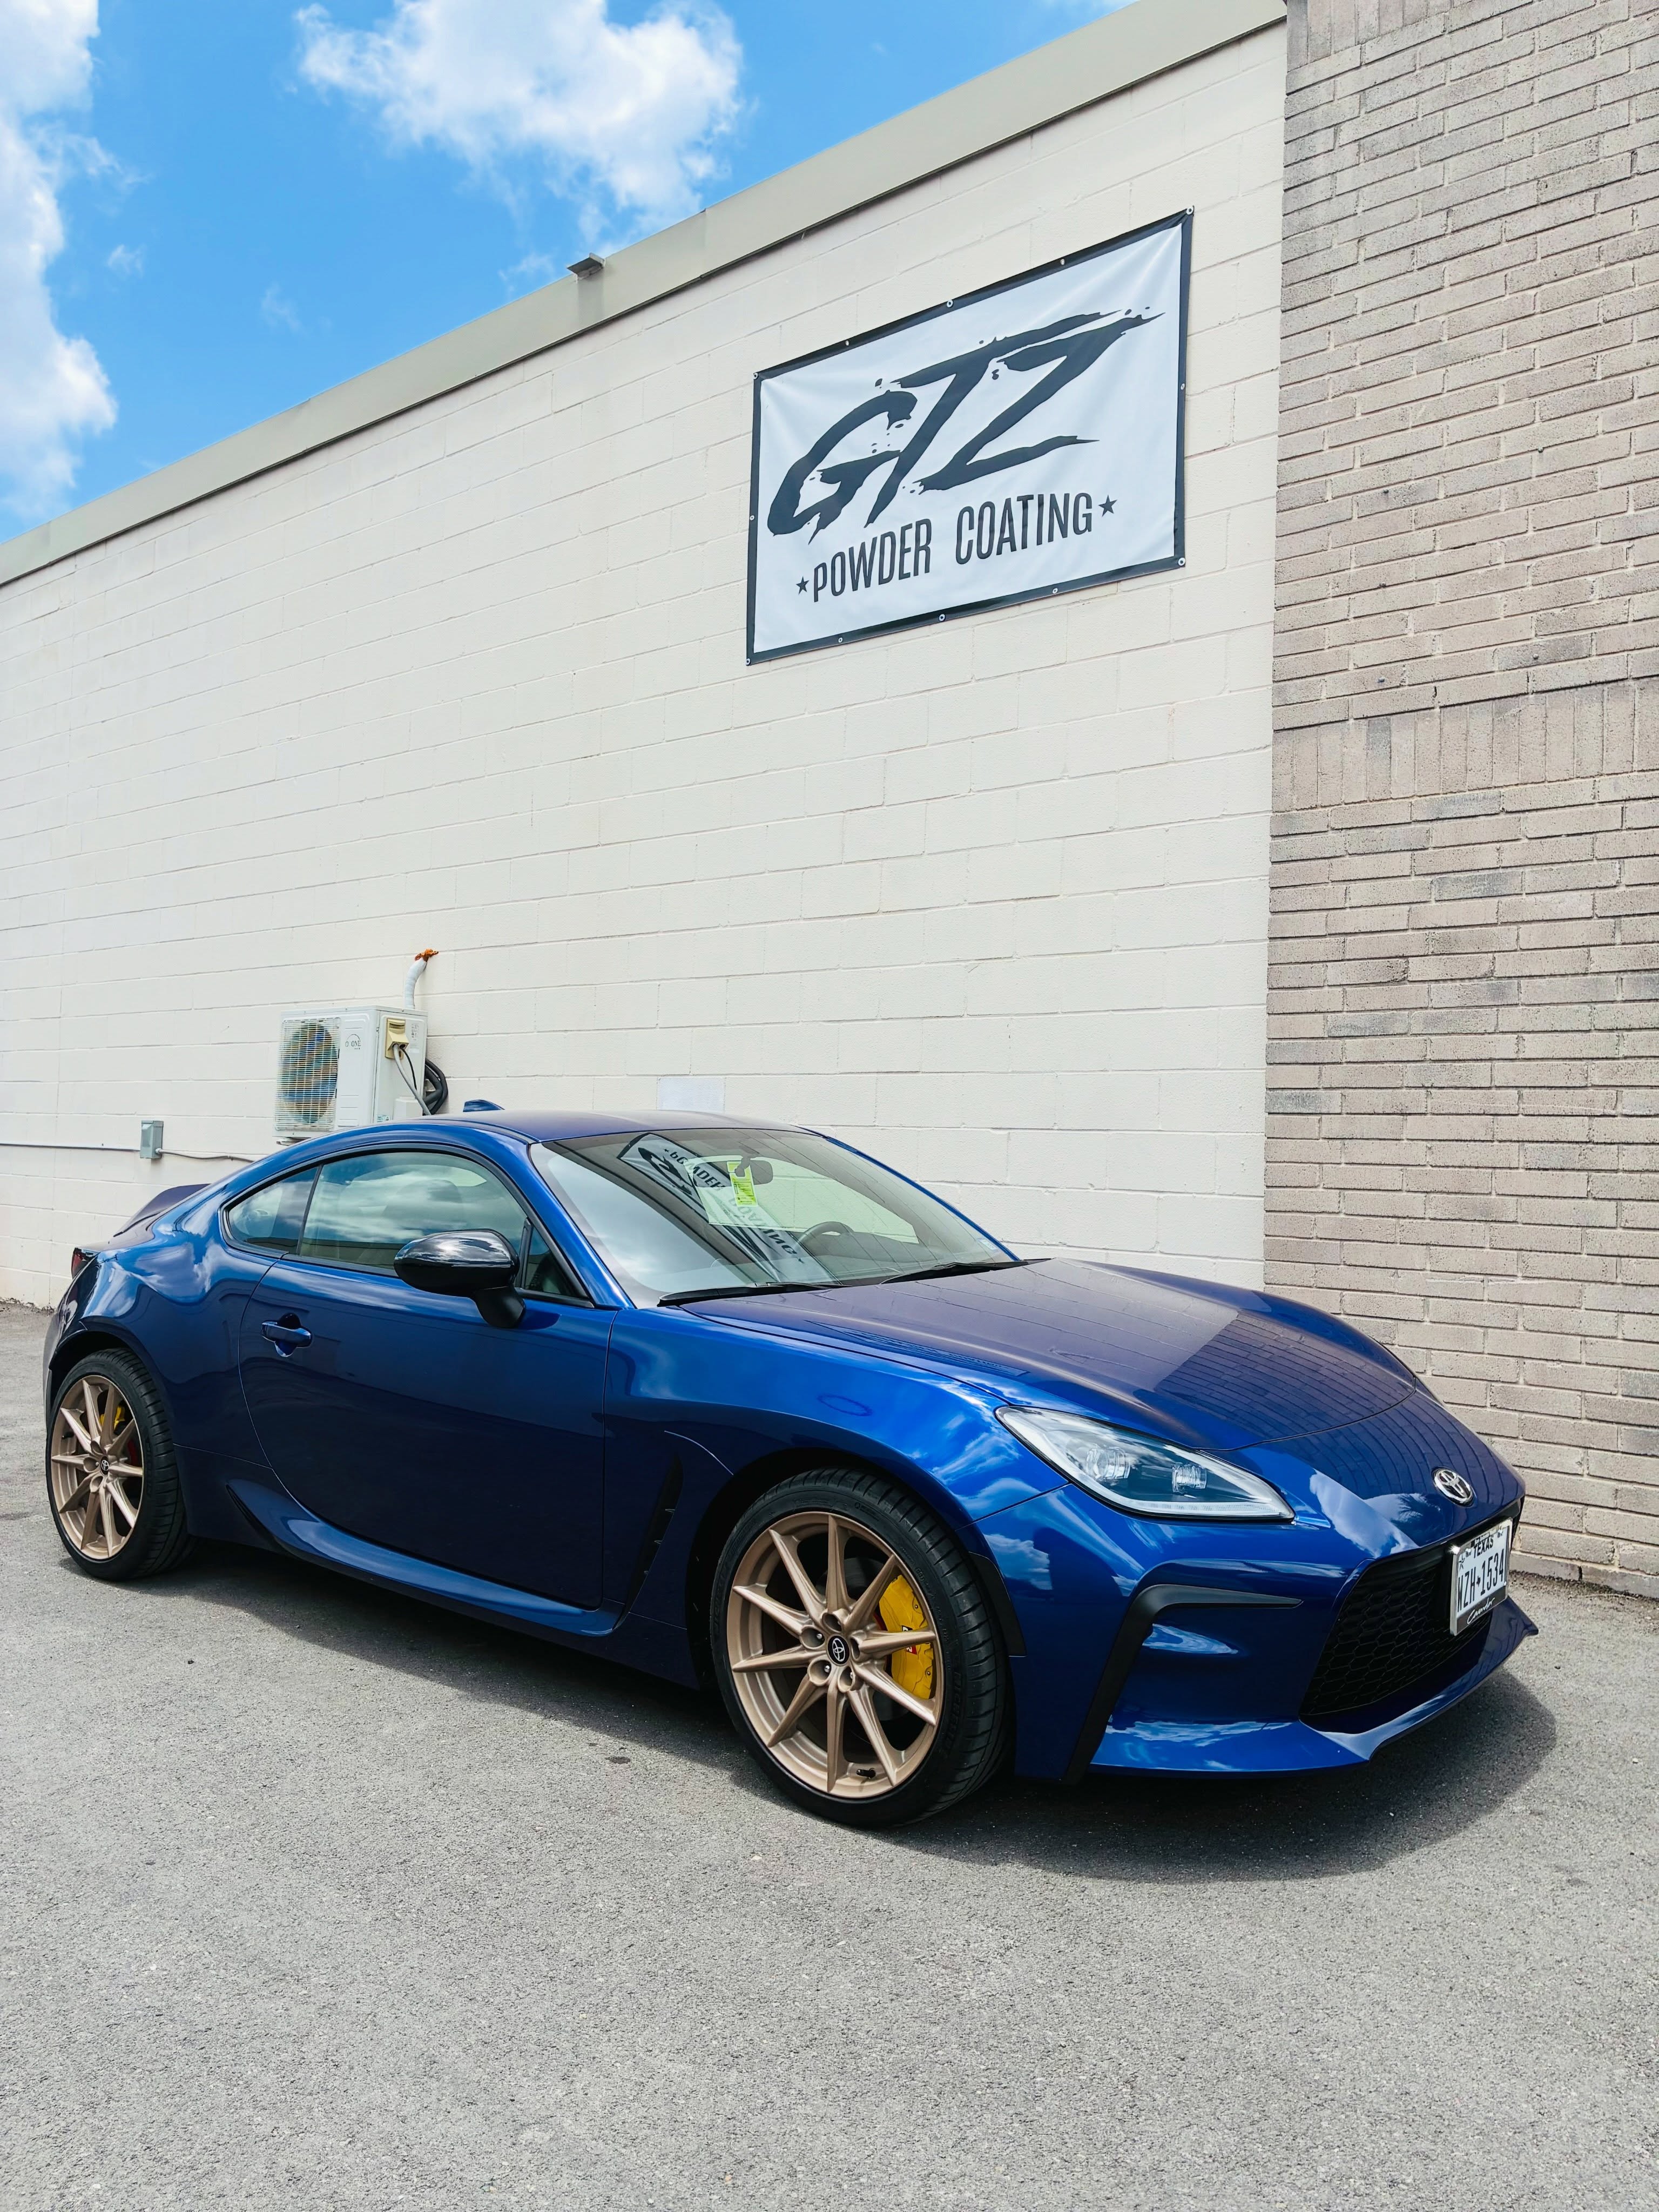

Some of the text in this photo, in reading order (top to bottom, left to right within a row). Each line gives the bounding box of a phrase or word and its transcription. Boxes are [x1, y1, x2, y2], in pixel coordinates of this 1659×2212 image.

[767, 309, 1165, 545] GTZ
[813, 492, 1093, 603] POWDER COATING
[1473, 1534, 1494, 1559] TEXAS
